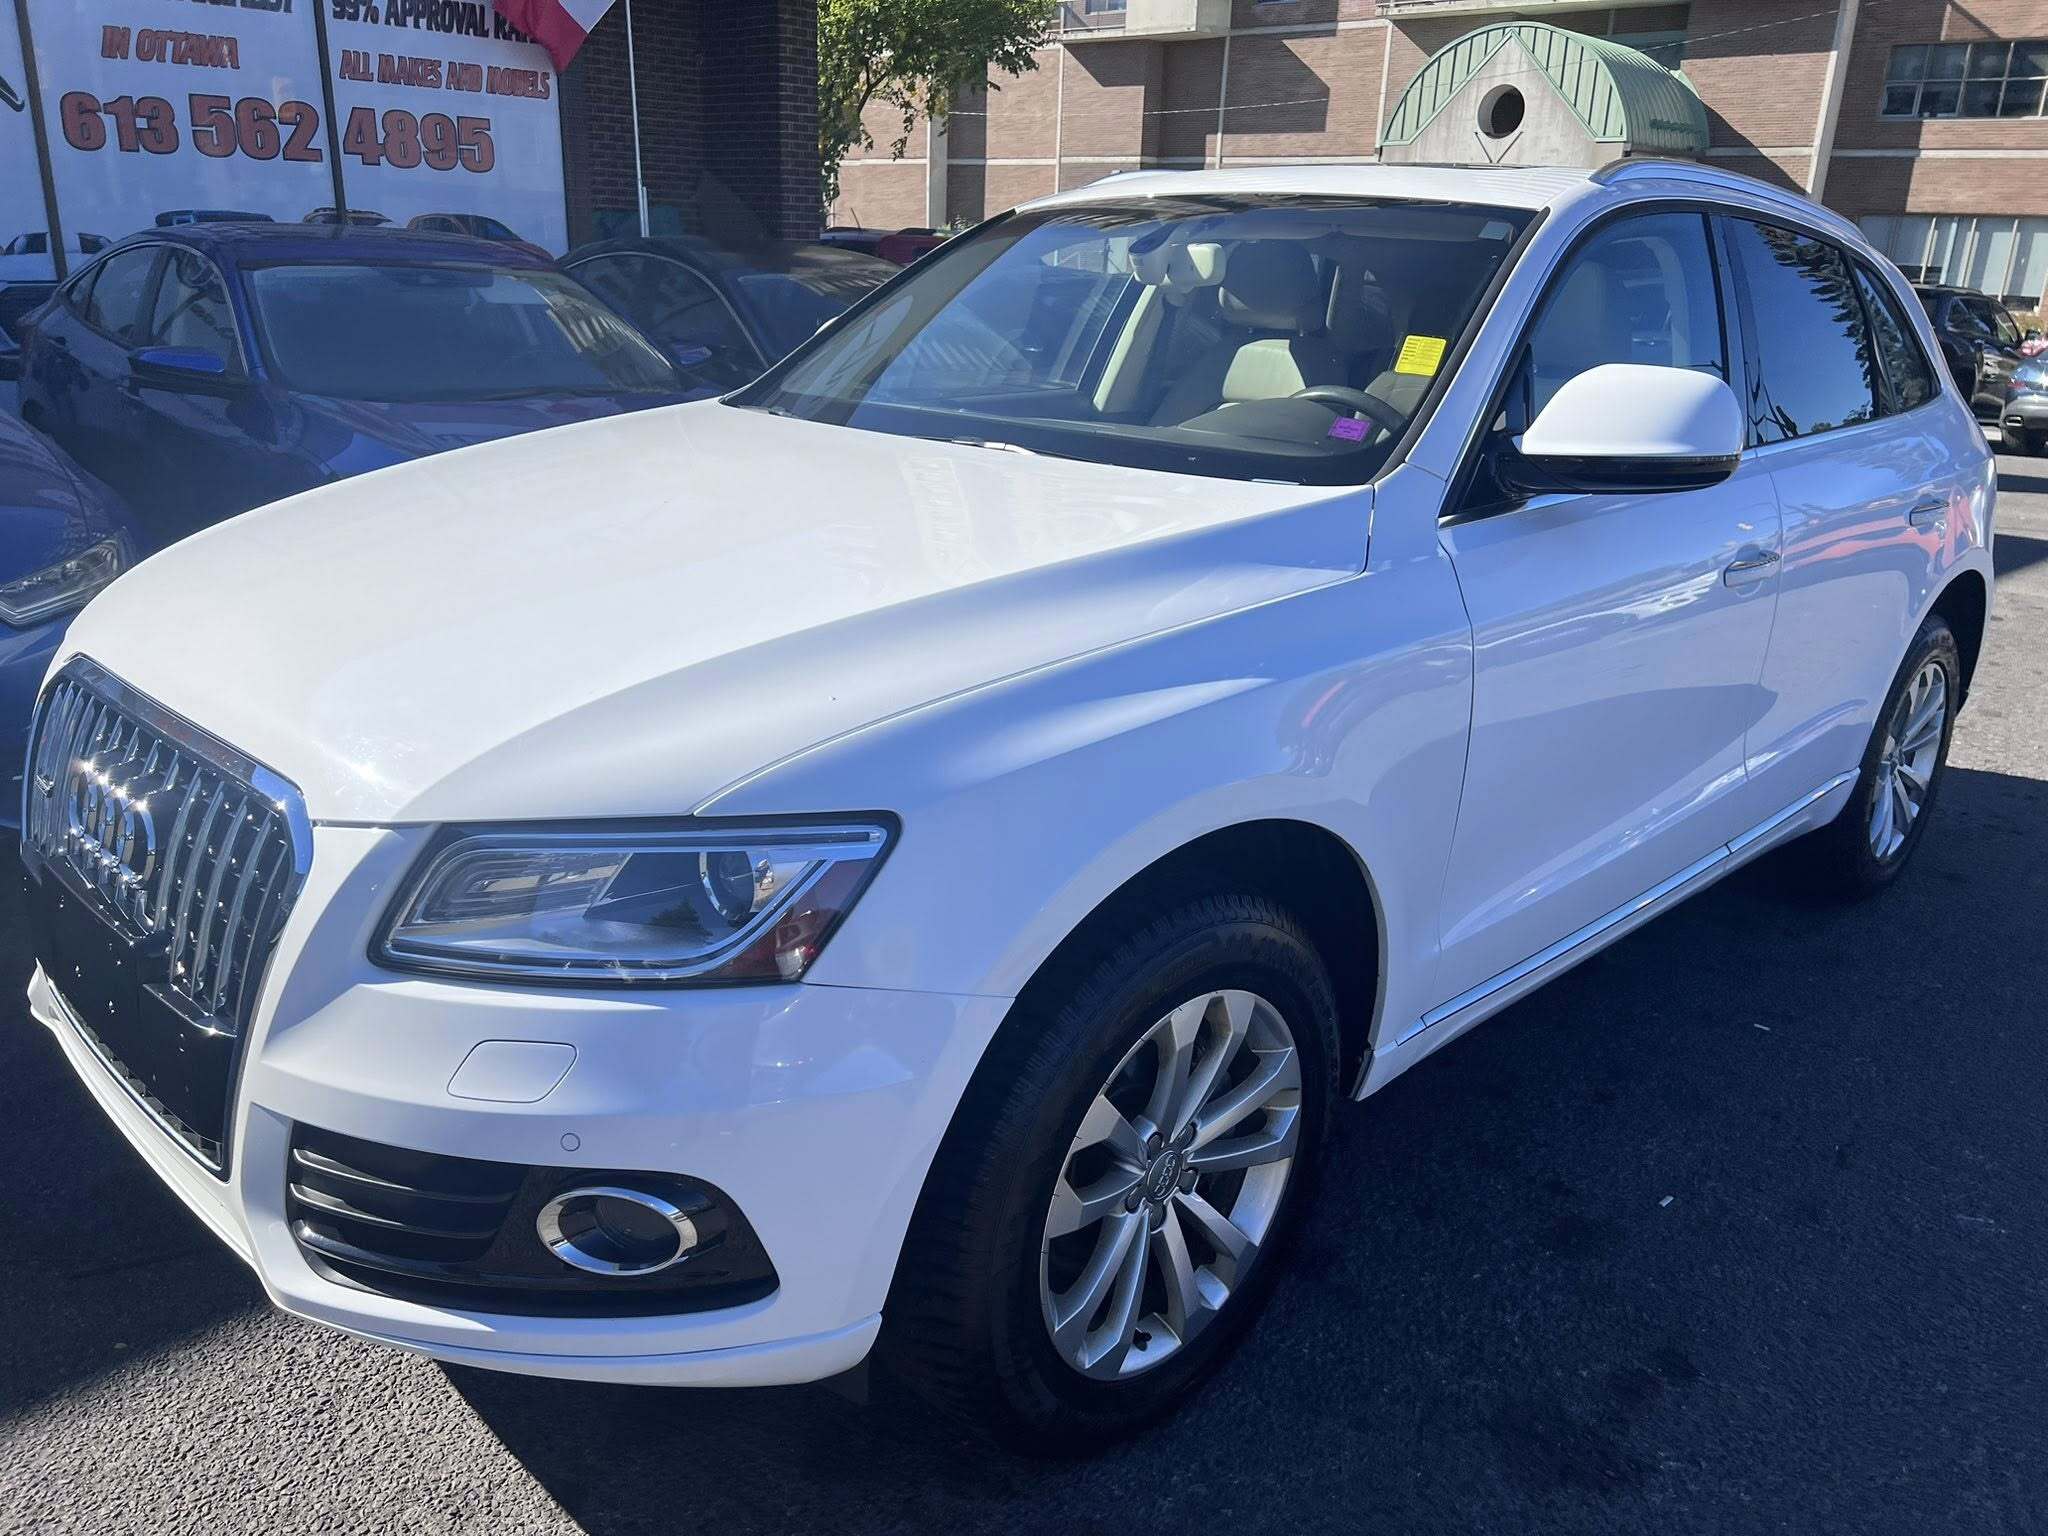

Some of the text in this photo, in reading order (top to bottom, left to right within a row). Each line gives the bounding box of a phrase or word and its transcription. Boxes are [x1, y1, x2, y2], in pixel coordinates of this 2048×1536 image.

[384, 0, 489, 38] APPROVAL
[101, 25, 240, 69] IN OTTAWA
[339, 49, 550, 99] ALL MAKES AND MODELS
[60, 91, 496, 173] 613 562 4895
